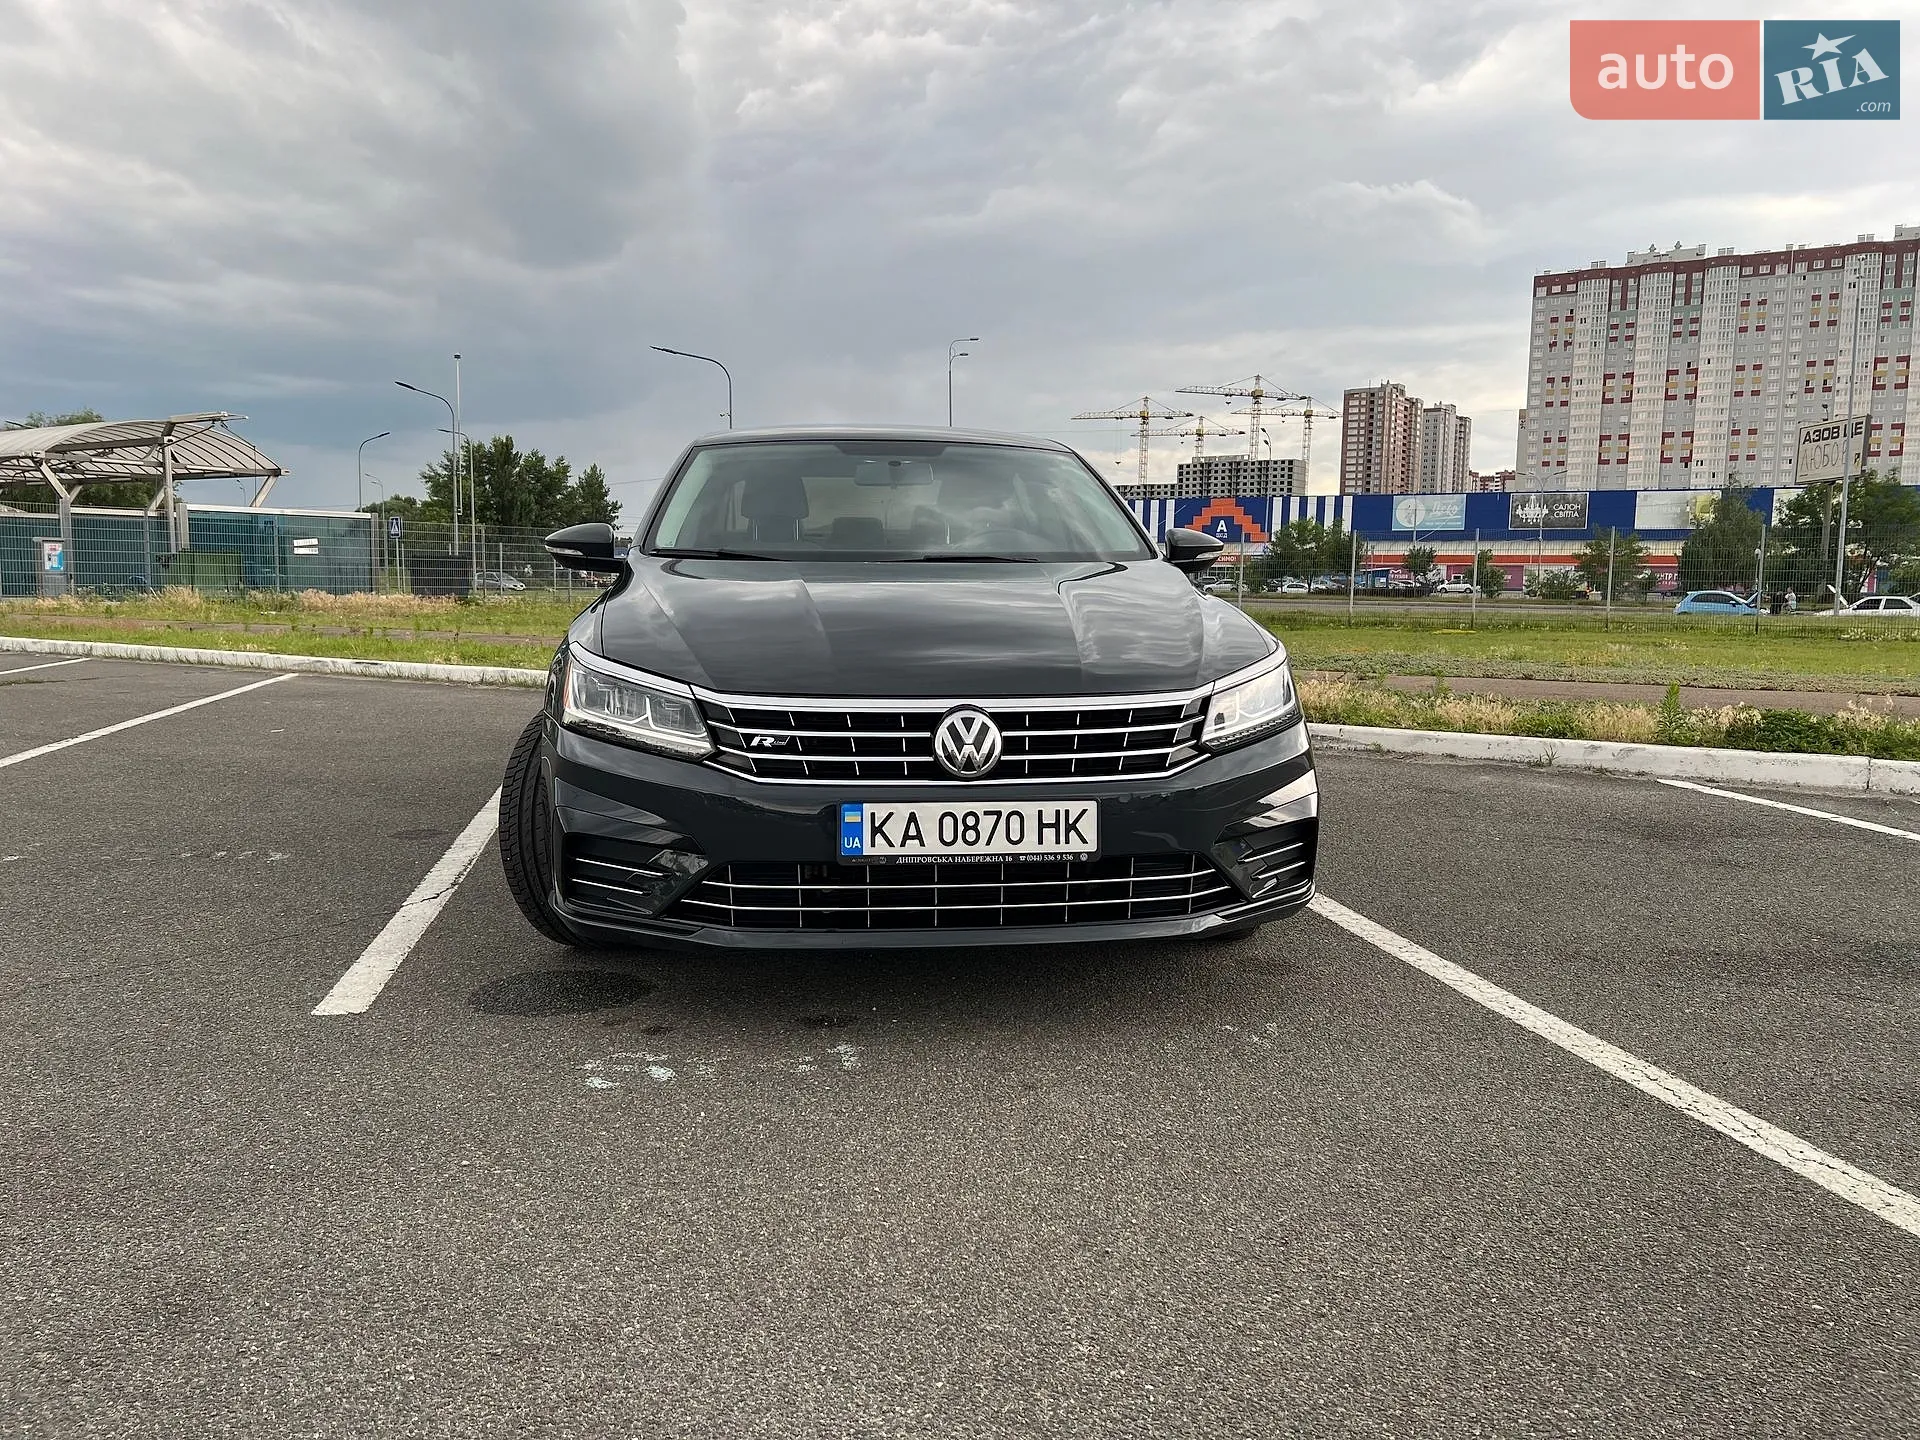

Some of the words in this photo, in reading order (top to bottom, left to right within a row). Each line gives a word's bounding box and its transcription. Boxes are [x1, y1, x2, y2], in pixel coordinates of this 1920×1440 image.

[1802, 425, 1840, 445] АЗОВ
[1553, 503, 1581, 511] САЛОН
[869, 811, 926, 848] KA
[938, 810, 1025, 847] 0870
[1037, 808, 1089, 845] HK
[844, 836, 862, 849] UA
[896, 856, 953, 864] ДНІПРОВСЬКА
[954, 855, 1004, 863] НАБЕРЕЖНА
